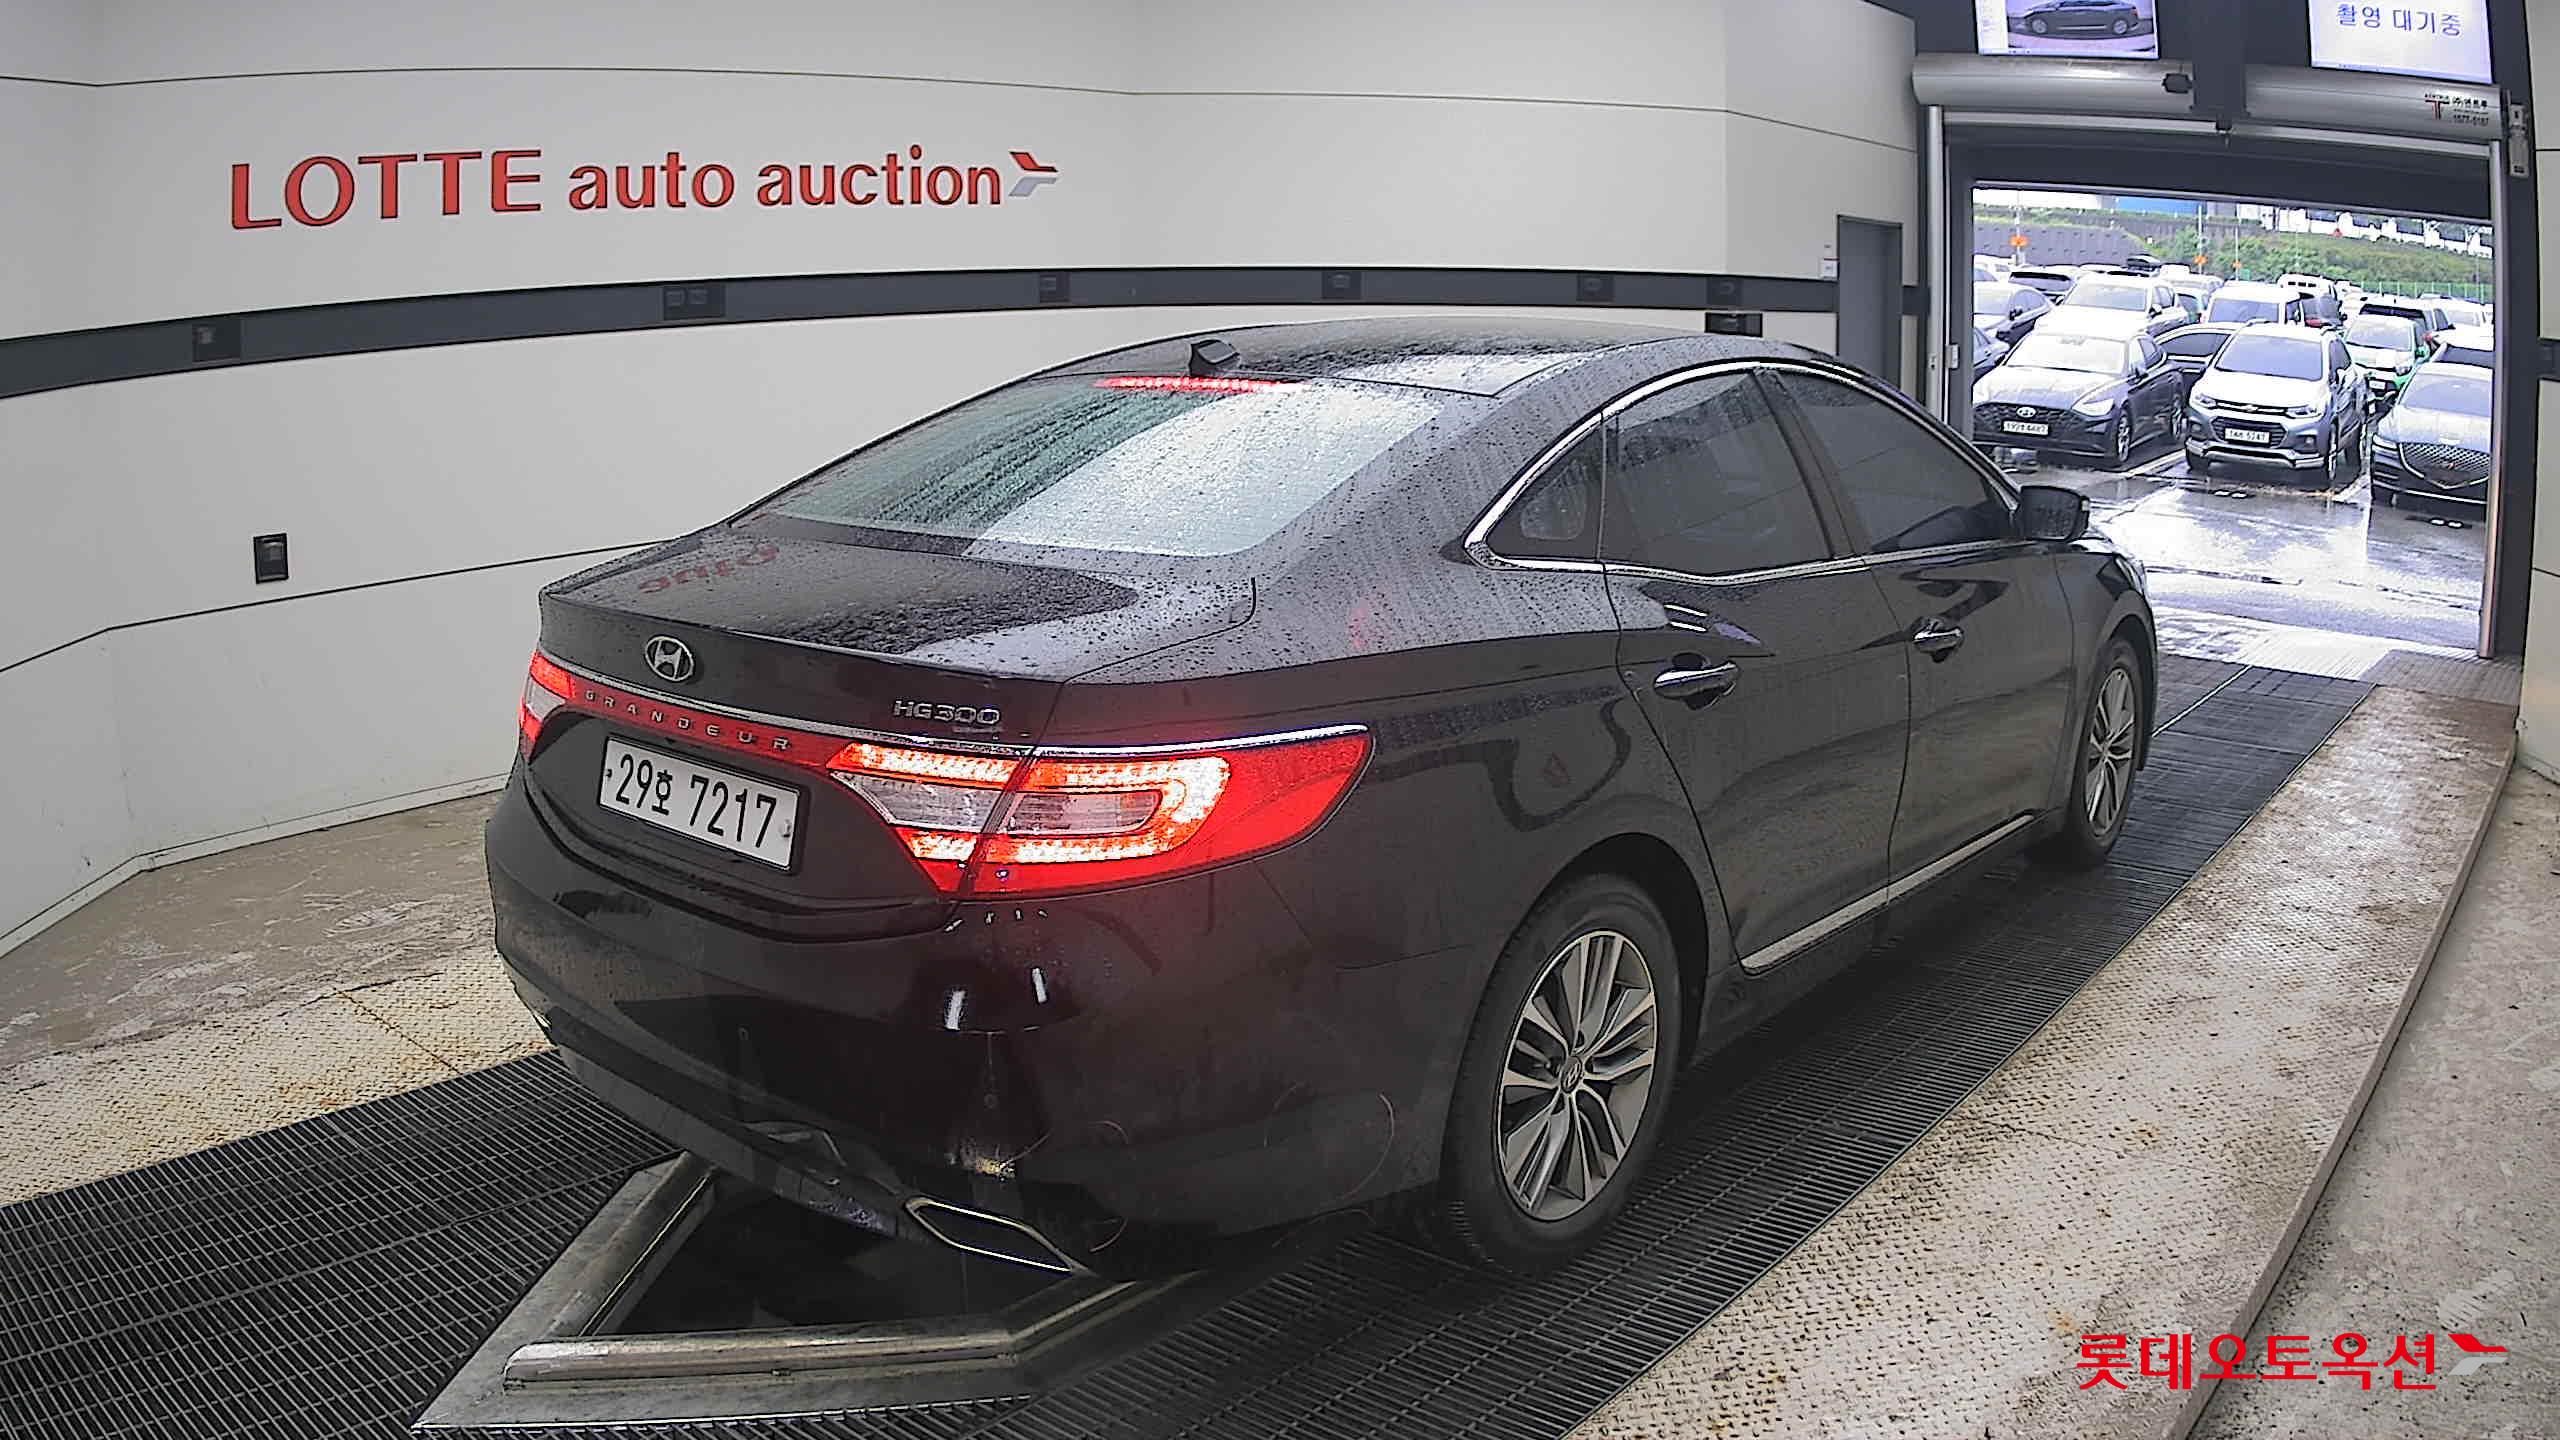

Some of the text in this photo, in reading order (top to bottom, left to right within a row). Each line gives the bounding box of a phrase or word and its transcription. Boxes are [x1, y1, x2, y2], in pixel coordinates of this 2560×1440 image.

[2337, 3, 2461, 37] 촬영 대기중
[231, 145, 1001, 230] LOTTE auto auction
[585, 689, 792, 750] GRANDEUR
[893, 700, 1000, 725] HG300
[615, 753, 777, 848] 29호 7217
